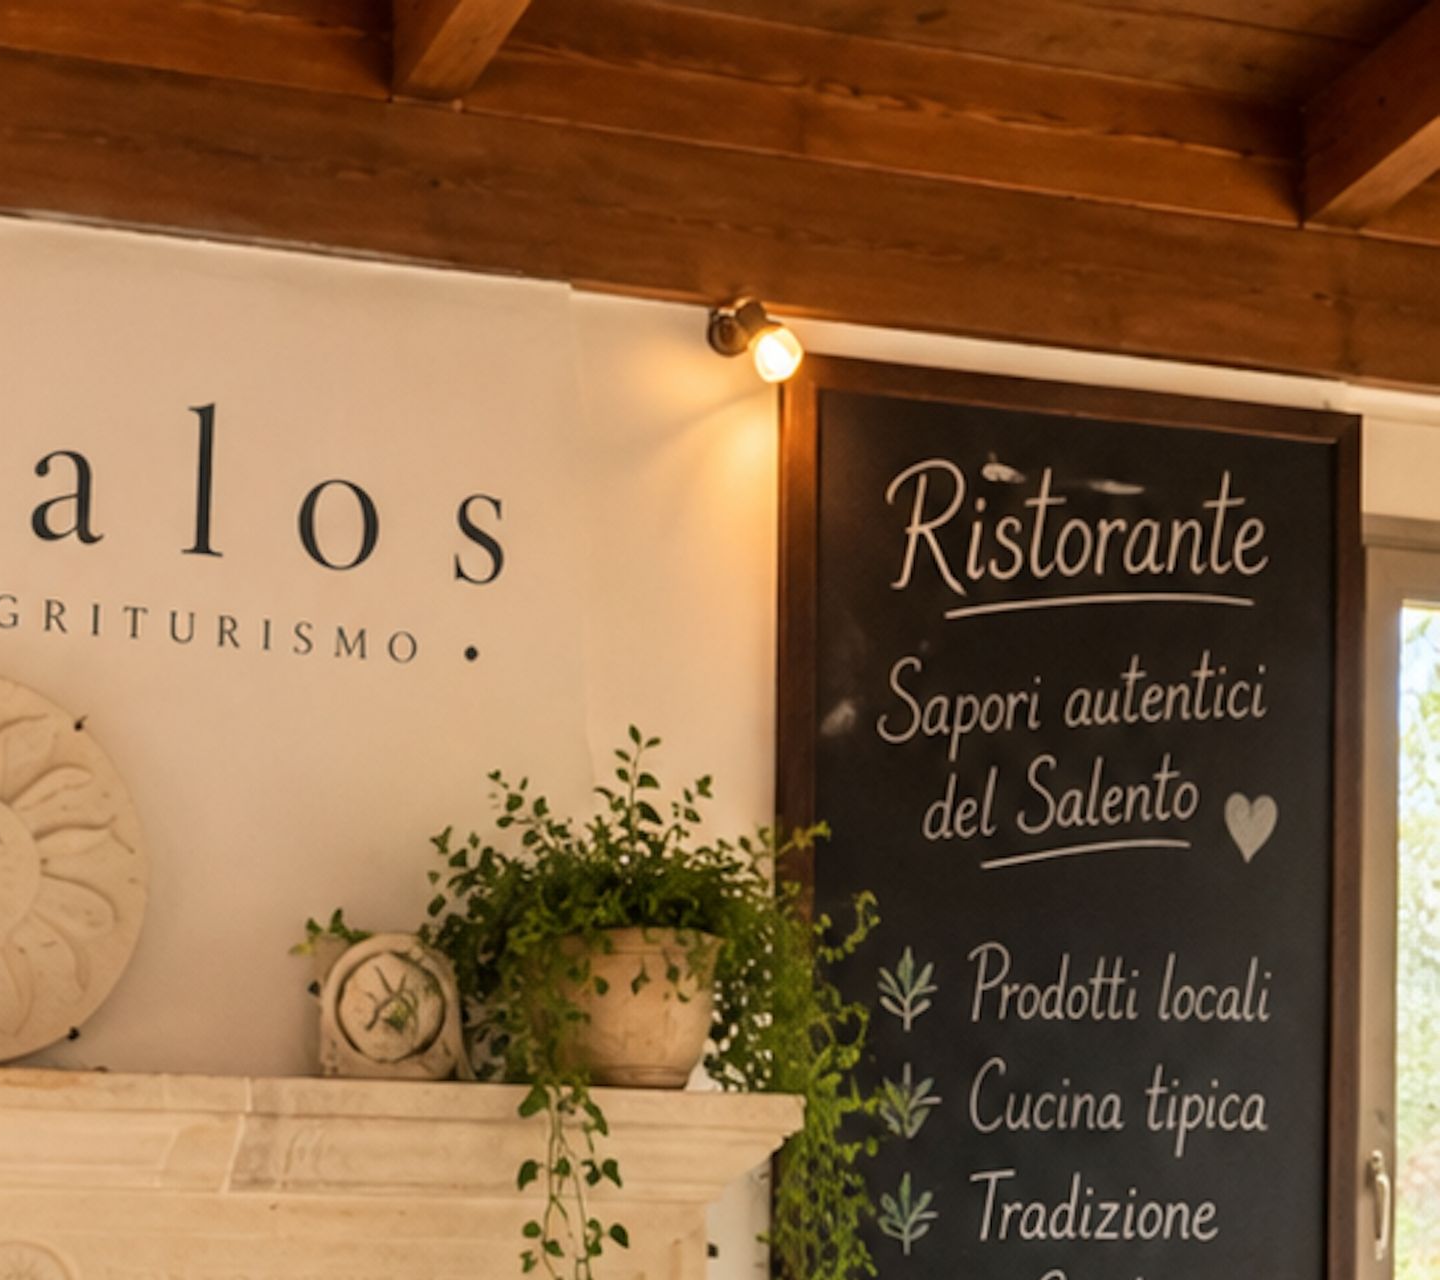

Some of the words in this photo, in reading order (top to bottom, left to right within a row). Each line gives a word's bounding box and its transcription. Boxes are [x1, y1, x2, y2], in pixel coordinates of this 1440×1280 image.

[885, 458, 1269, 596] Ristorante
[876, 656, 1042, 762] Sapori
[1064, 649, 1268, 730] autentici
[922, 766, 999, 842] del
[1016, 752, 1201, 836] Salento
[967, 941, 1140, 1022] Prodotti
[1158, 952, 1273, 1023] locali
[968, 1056, 1125, 1133] Cucina
[1145, 1062, 1269, 1159] tipica
[969, 1168, 1220, 1243] Tradizione
